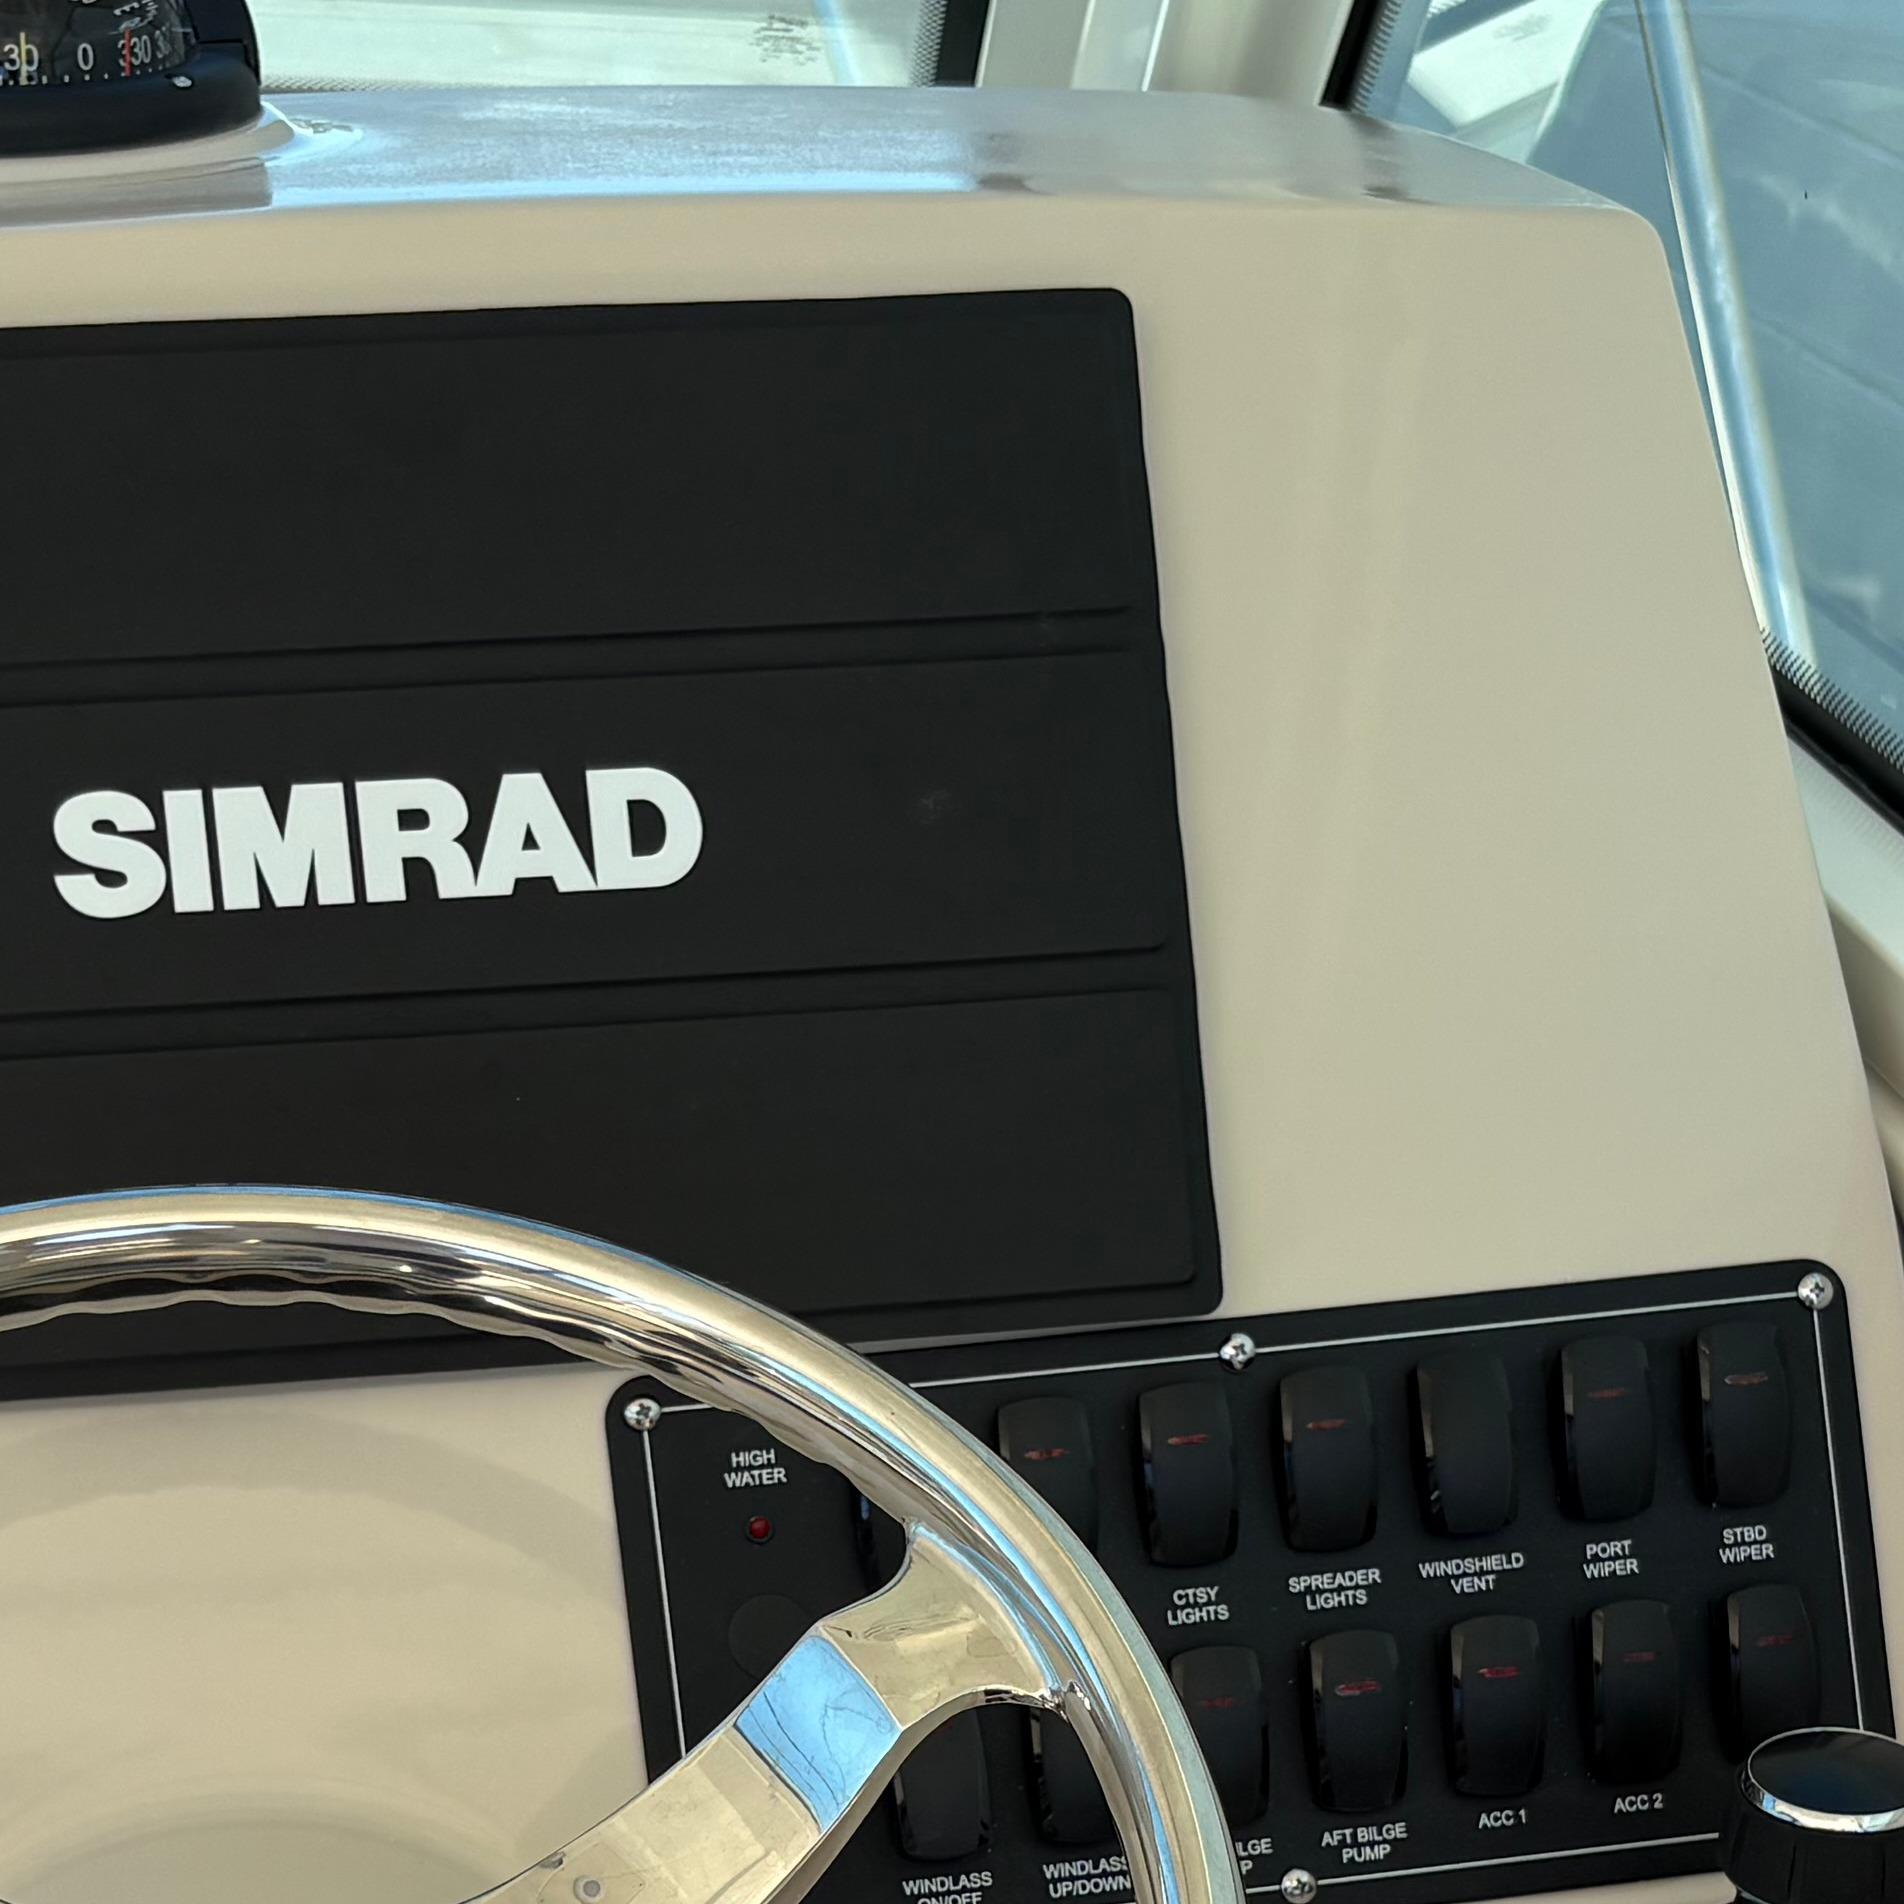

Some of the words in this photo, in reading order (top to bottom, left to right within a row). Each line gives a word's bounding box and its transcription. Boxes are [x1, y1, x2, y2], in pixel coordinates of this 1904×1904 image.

[3, 43, 39, 72] 30
[77, 43, 94, 71] 0
[53, 767, 703, 919] SIMRAD
[731, 1448, 776, 1468] HIGH
[723, 1467, 787, 1488] WATER
[1723, 1525, 1767, 1544] STBD
[1586, 1539, 1632, 1559] PORT
[1719, 1543, 1775, 1564] WIPER
[1418, 1552, 1524, 1578] WINDSHIELD
[1583, 1558, 1639, 1579] WIPER
[1288, 1568, 1382, 1593] SPREADER
[1450, 1574, 1496, 1594] VENT
[1173, 1586, 1219, 1606] CTSY
[1306, 1589, 1368, 1610] LIGHTS
[1167, 1604, 1230, 1626] LIGHTS
[1614, 1794, 1649, 1813] ACC
[1652, 1793, 1663, 1809] 2
[1478, 1811, 1514, 1829] ACC
[1518, 1808, 1526, 1824] 1
[1321, 1829, 1353, 1848] AFT
[1356, 1823, 1408, 1843] BILGE
[1342, 1843, 1391, 1864] PUMP
[902, 1871, 993, 1896] WINDLASS
[1048, 1873, 1131, 1899] UP/DOWN
